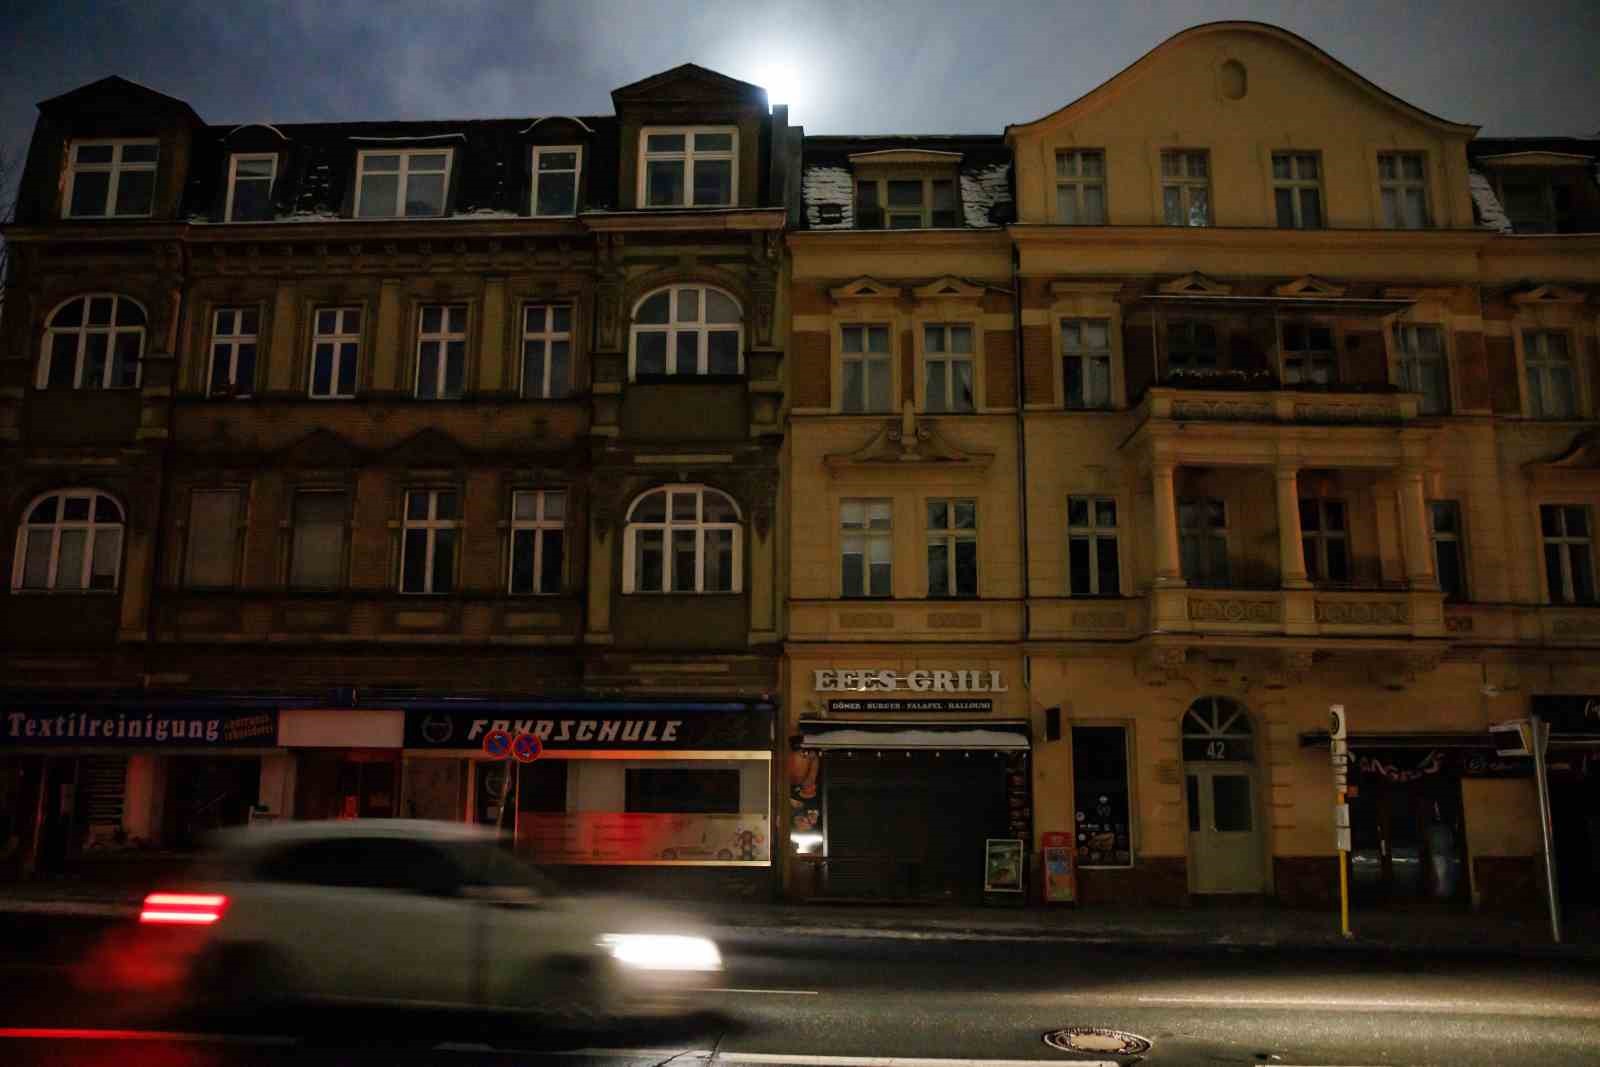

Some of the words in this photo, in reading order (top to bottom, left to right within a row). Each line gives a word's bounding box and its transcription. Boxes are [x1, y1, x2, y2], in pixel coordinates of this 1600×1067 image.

[906, 669, 1009, 692] GRILL
[7, 711, 220, 741] Textilreinigung
[467, 719, 683, 742] FAHRSCHULE
[1206, 740, 1225, 760] 42
